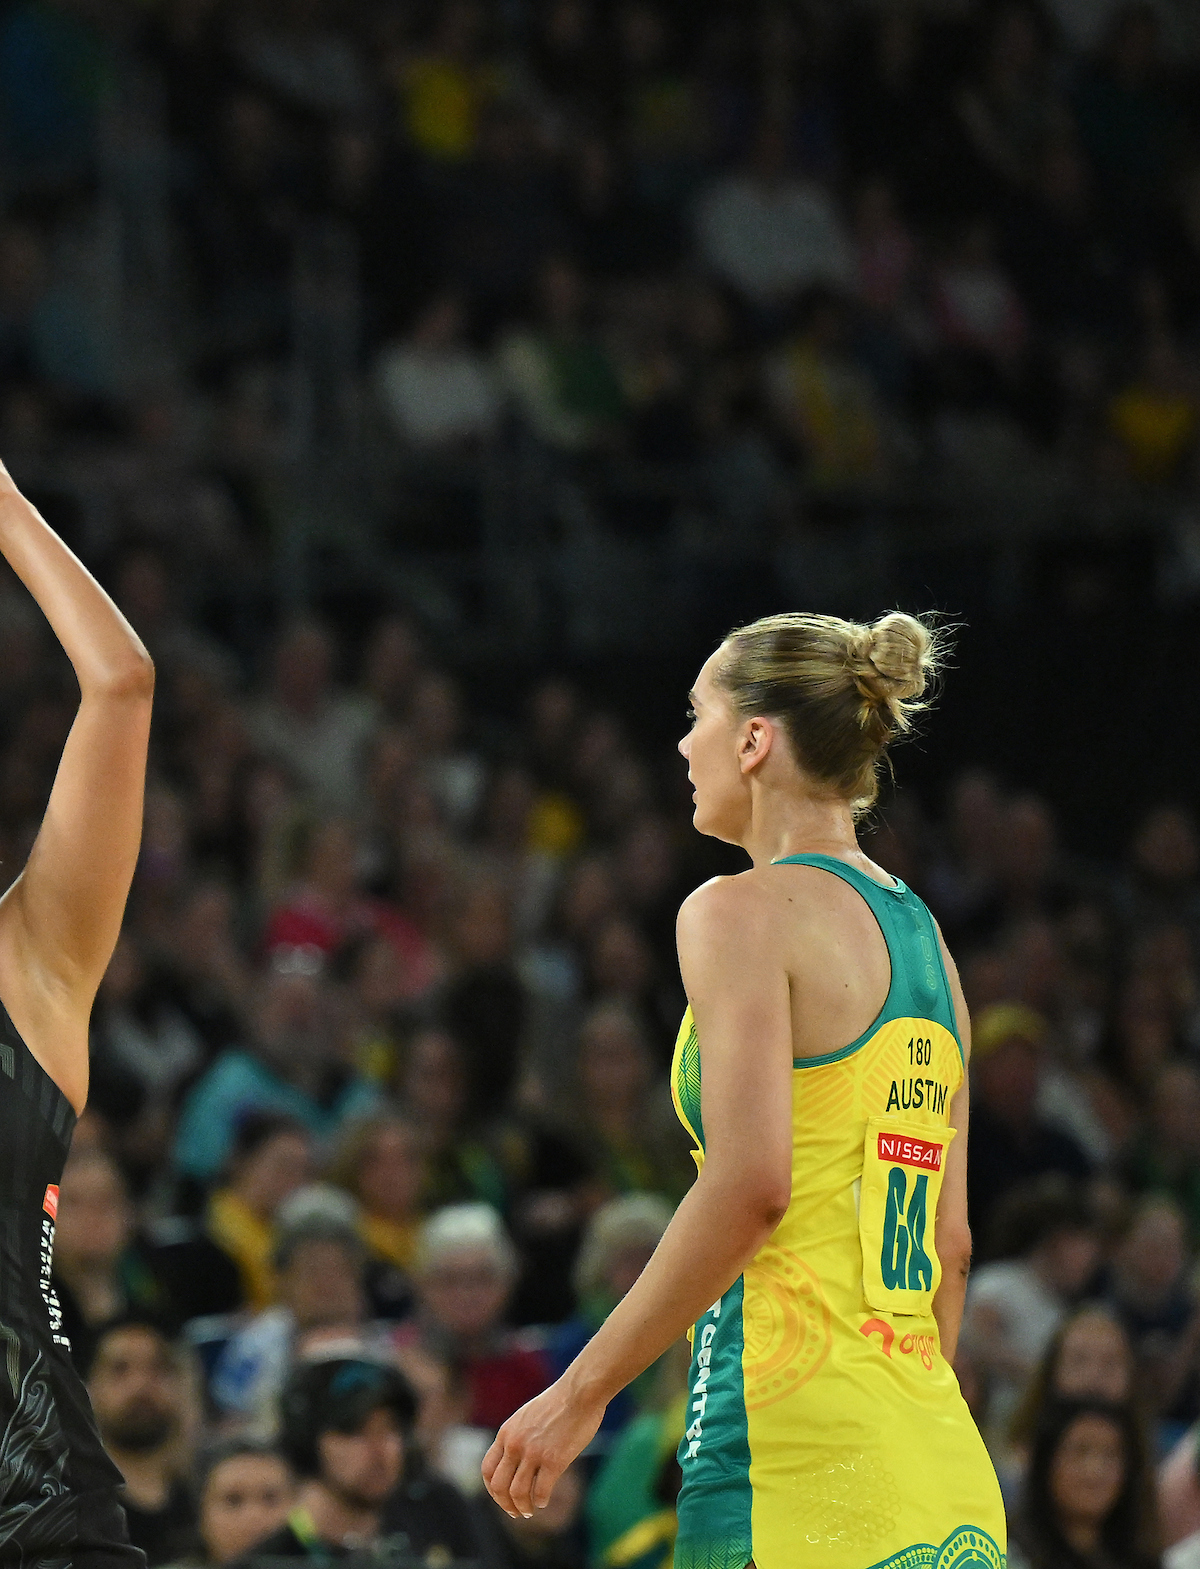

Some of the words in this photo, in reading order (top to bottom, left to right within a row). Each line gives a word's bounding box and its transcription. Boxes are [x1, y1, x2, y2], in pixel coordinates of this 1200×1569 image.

[907, 1037, 932, 1066] 180
[886, 1078, 948, 1115] AUSTIN
[880, 1167, 933, 1291] GA
[684, 1324, 716, 1459] CENTRE
